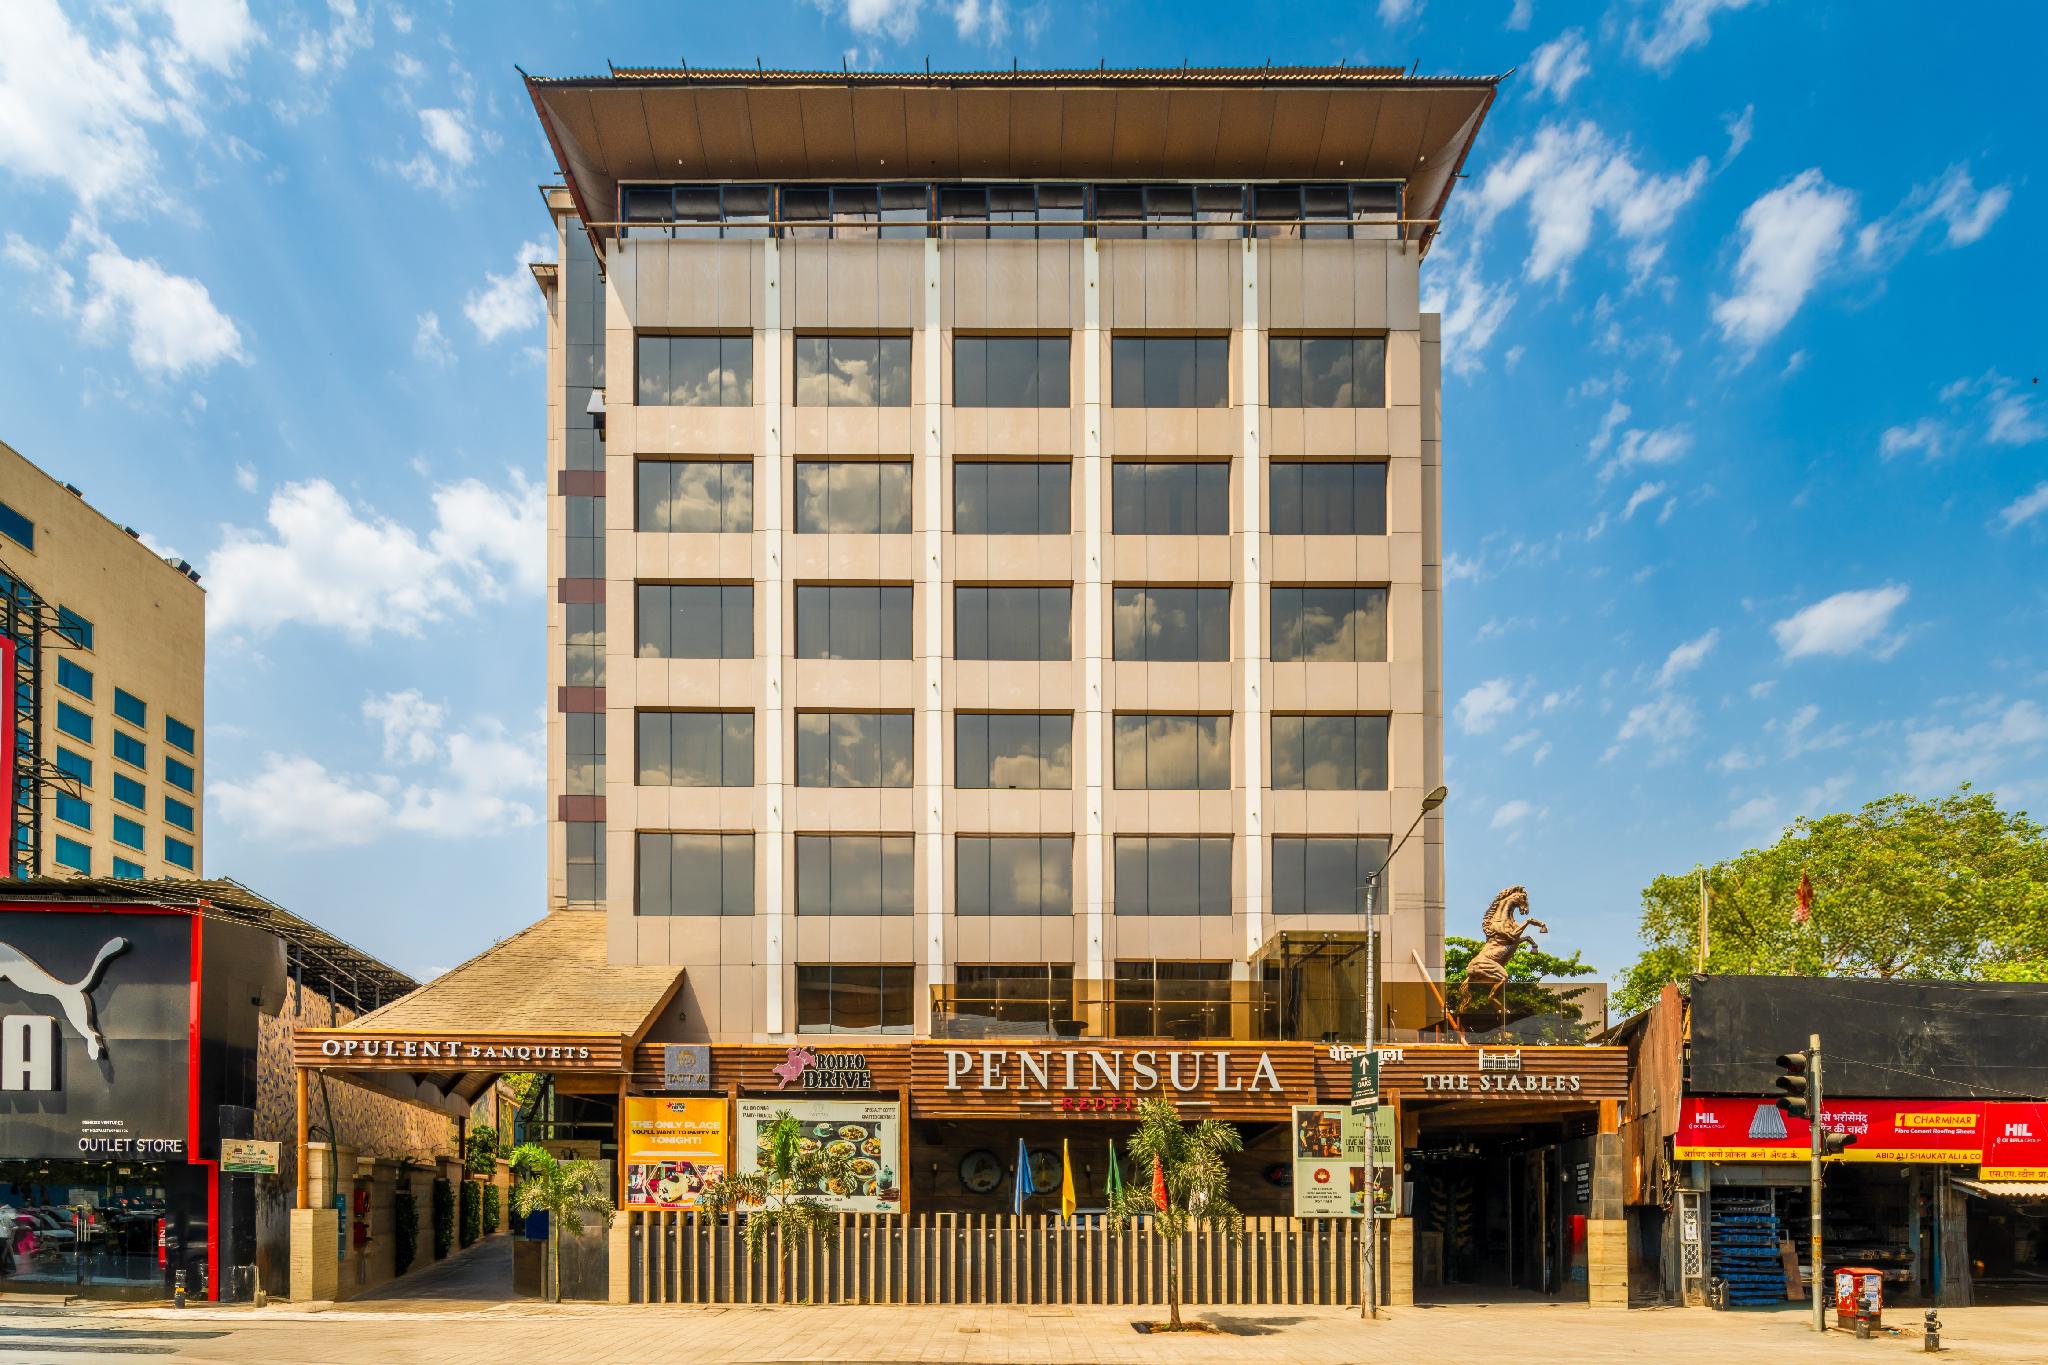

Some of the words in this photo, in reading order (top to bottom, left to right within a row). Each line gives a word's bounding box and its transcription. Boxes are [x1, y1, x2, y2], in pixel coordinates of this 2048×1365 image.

[321, 1040, 463, 1057] OPULENT
[470, 1046, 589, 1060] BANQUETS
[816, 1053, 866, 1070] RODEO
[803, 1069, 871, 1089] DRIVE
[943, 1050, 1284, 1092] PENINSULA
[1422, 1074, 1469, 1091] THE
[1479, 1075, 1581, 1092] STABLES
[630, 1120, 654, 1129] THE
[654, 1121, 683, 1129] ONLY
[684, 1121, 721, 1129] PLACE
[1913, 1115, 1972, 1125] CHARMINAR
[78, 1137, 132, 1152] OUTLET
[136, 1138, 183, 1152] STORE
[650, 1136, 702, 1145] TONIGHT!
[1896, 1152, 1908, 1160] ALI
[1911, 1152, 1947, 1160] SHAUKAT
